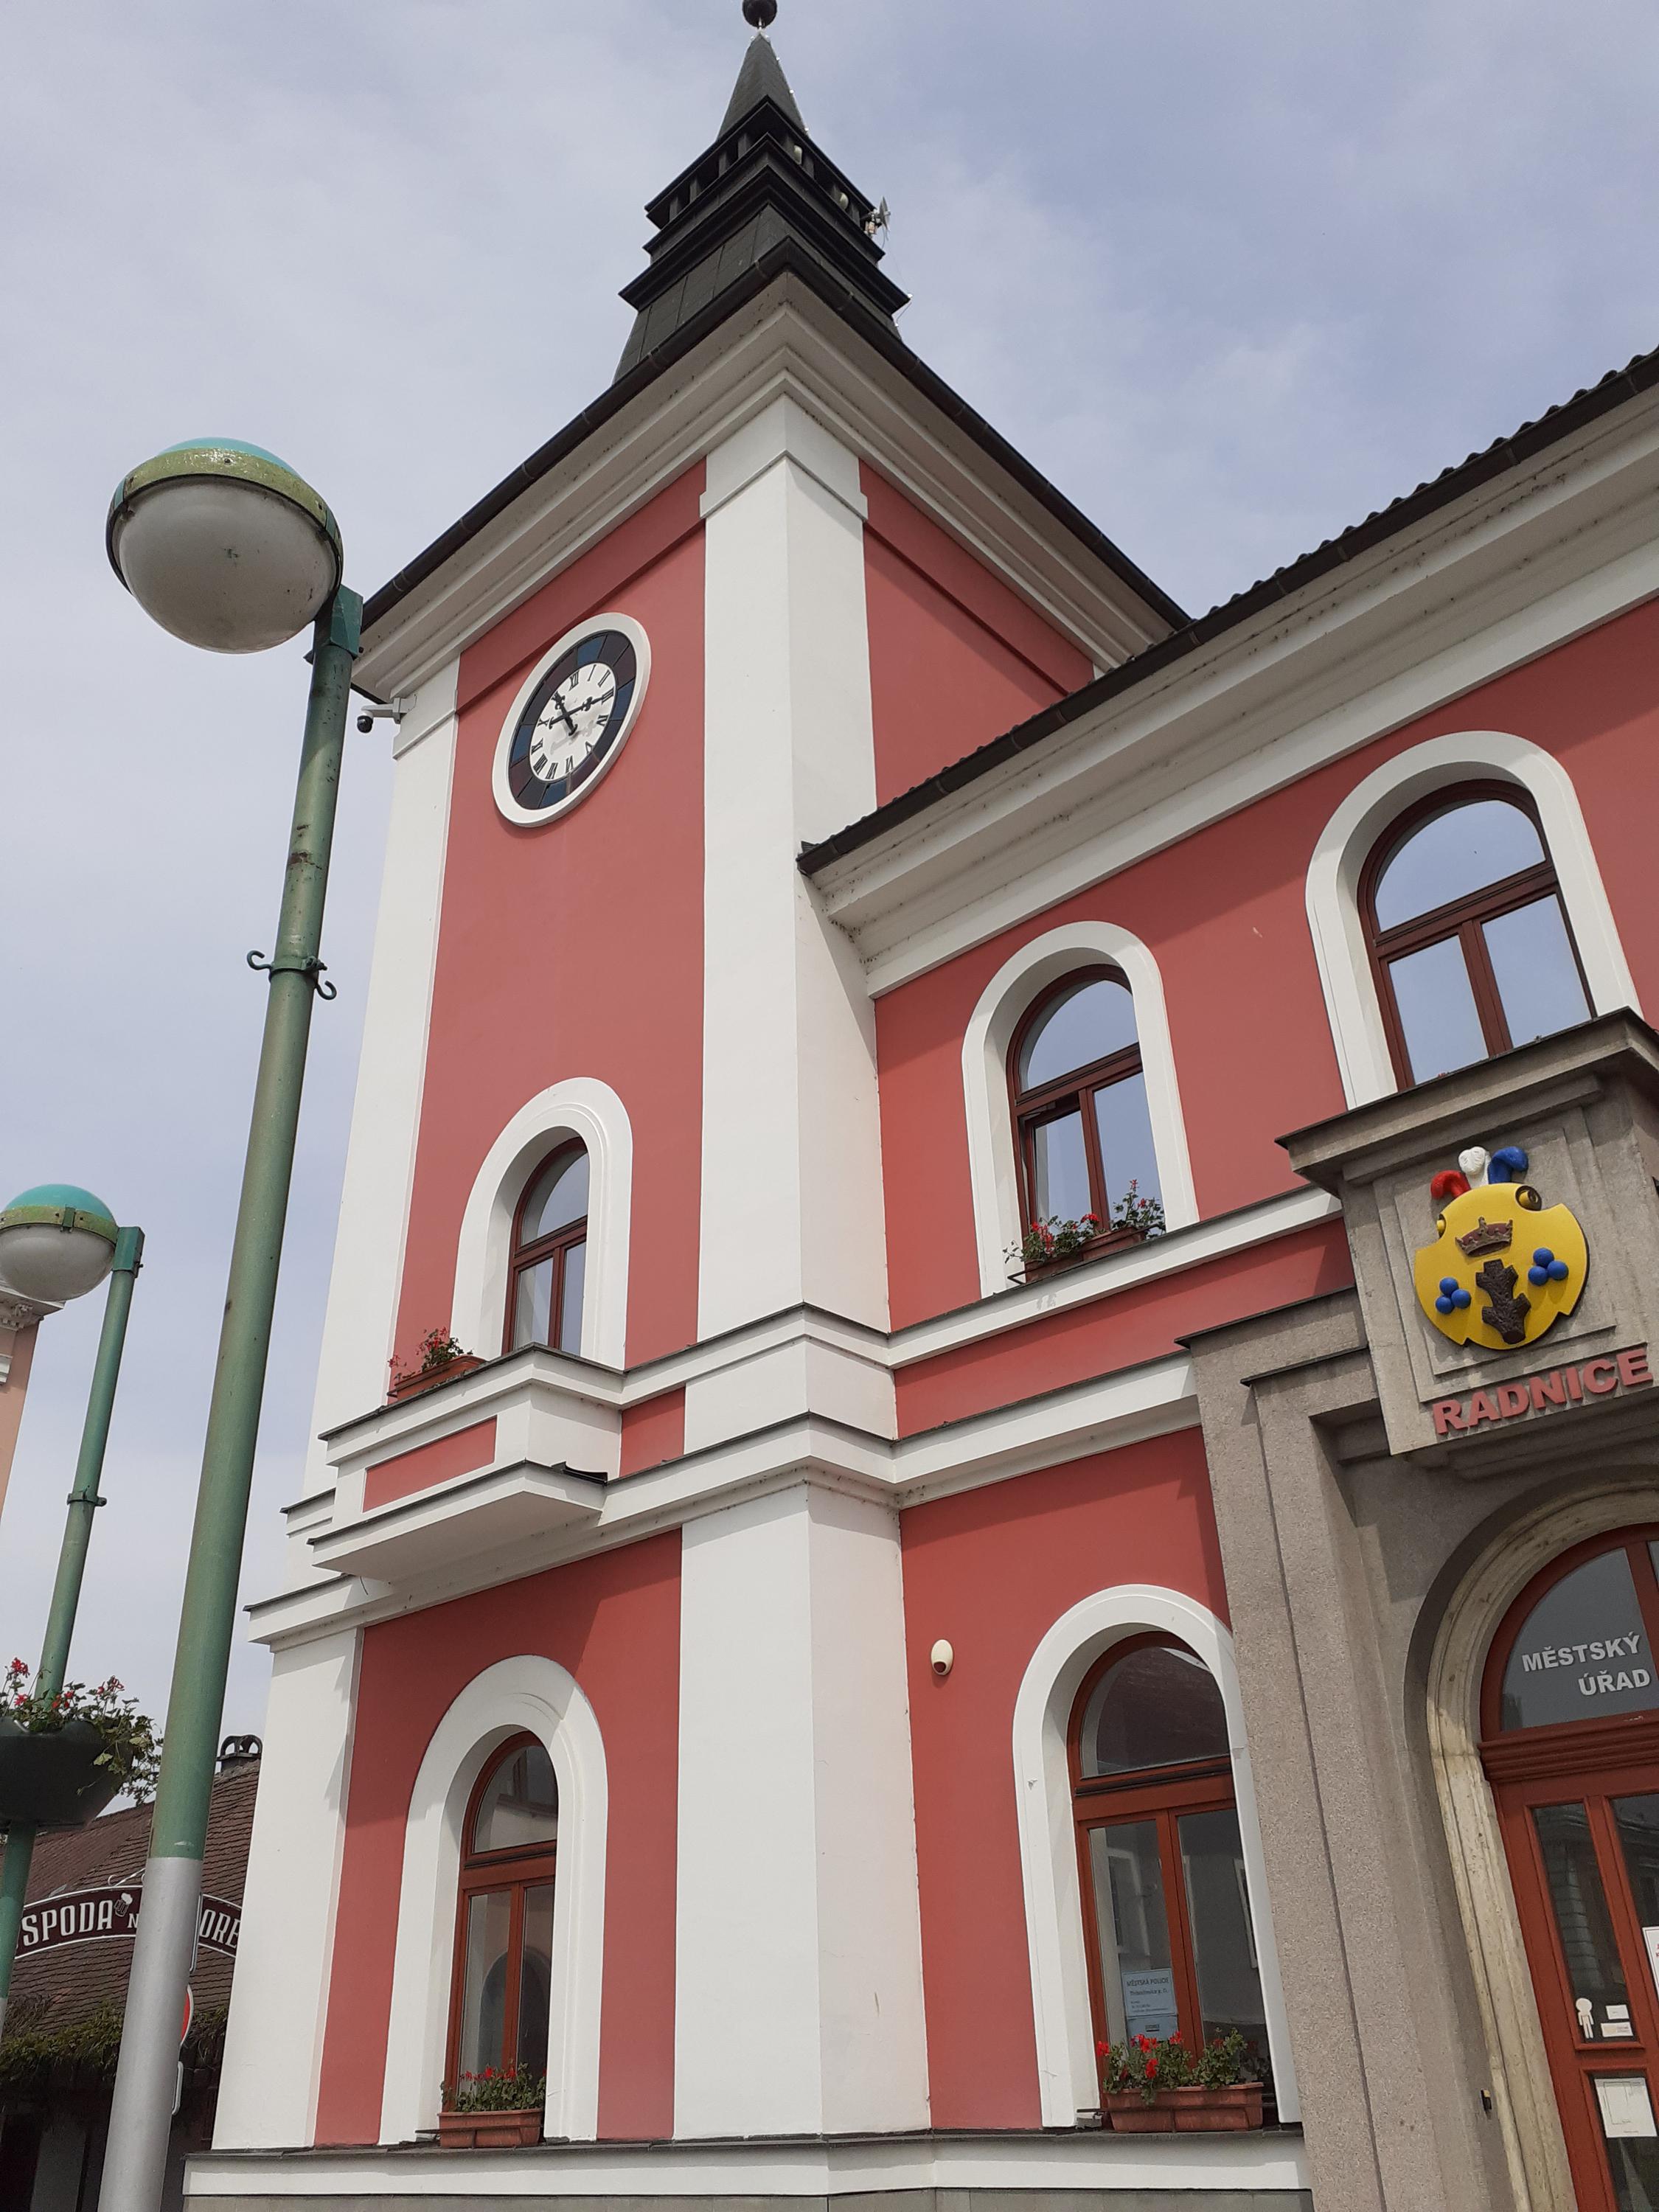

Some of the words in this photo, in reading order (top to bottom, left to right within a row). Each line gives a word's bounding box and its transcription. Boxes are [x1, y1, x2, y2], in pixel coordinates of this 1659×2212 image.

[568, 669, 579, 692] XII
[597, 669, 611, 688] II
[537, 718, 550, 728] X
[596, 714, 610, 727] IV
[531, 737, 543, 756] IX
[585, 741, 596, 754] V
[532, 753, 549, 776] VIII
[566, 755, 574, 774] VI
[1432, 1348, 1653, 1435] RADNICE
[1521, 1631, 1641, 1672] MĚSTSKÝ
[1577, 1669, 1652, 1696] ÚŘAD
[18, 1899, 113, 1947] SPODA
